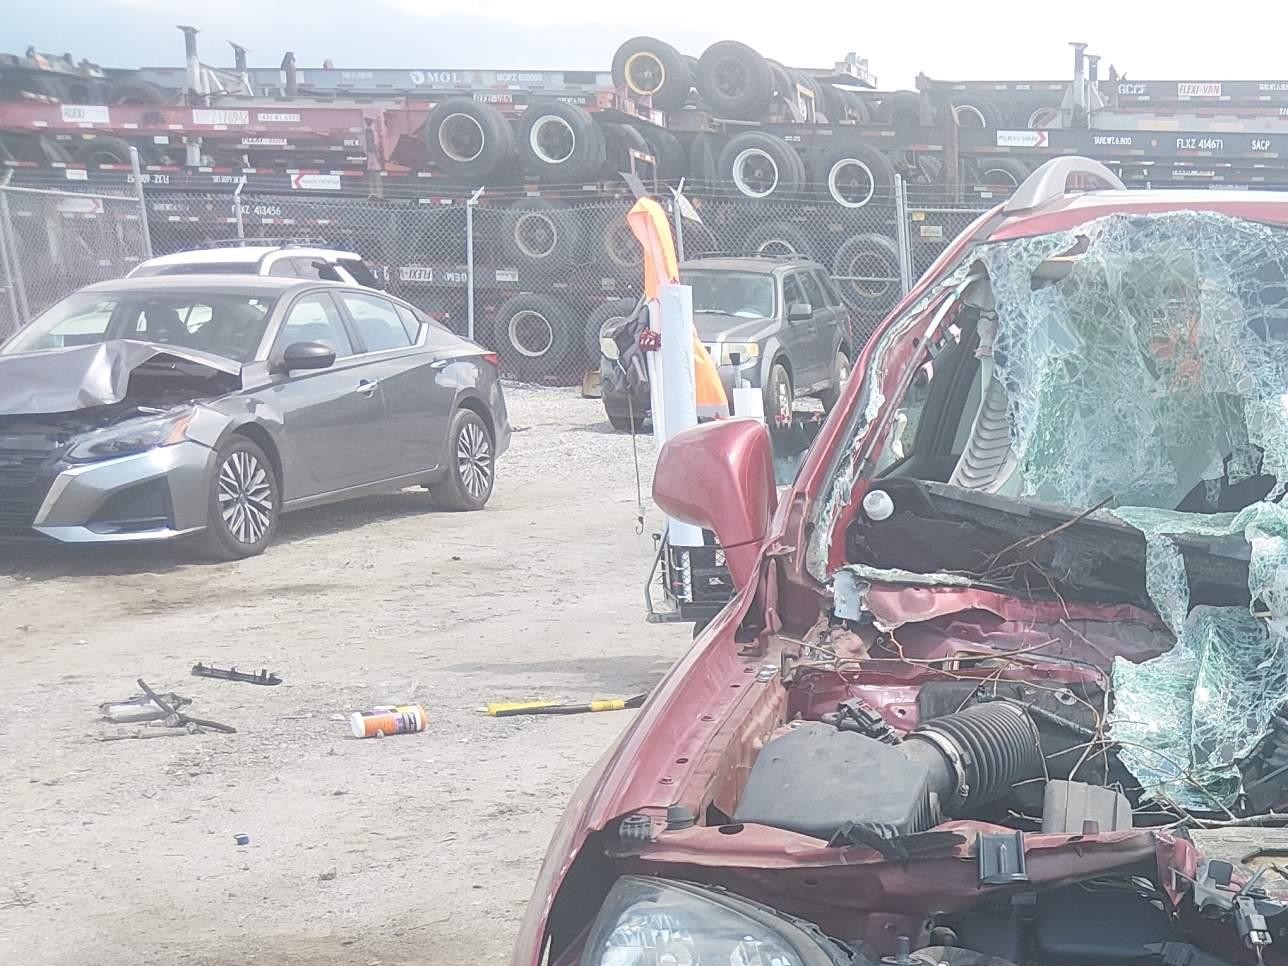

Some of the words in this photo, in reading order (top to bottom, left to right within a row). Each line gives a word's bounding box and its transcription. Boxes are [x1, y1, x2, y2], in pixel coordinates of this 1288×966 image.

[427, 72, 461, 82] MOL
[1179, 86, 1220, 94] FLEXI-VAN
[1177, 139, 1196, 149] FLXZ
[1198, 139, 1223, 149] 414671
[1252, 140, 1270, 150] SACP
[232, 205, 250, 215] FXZ
[254, 206, 281, 216] 413456
